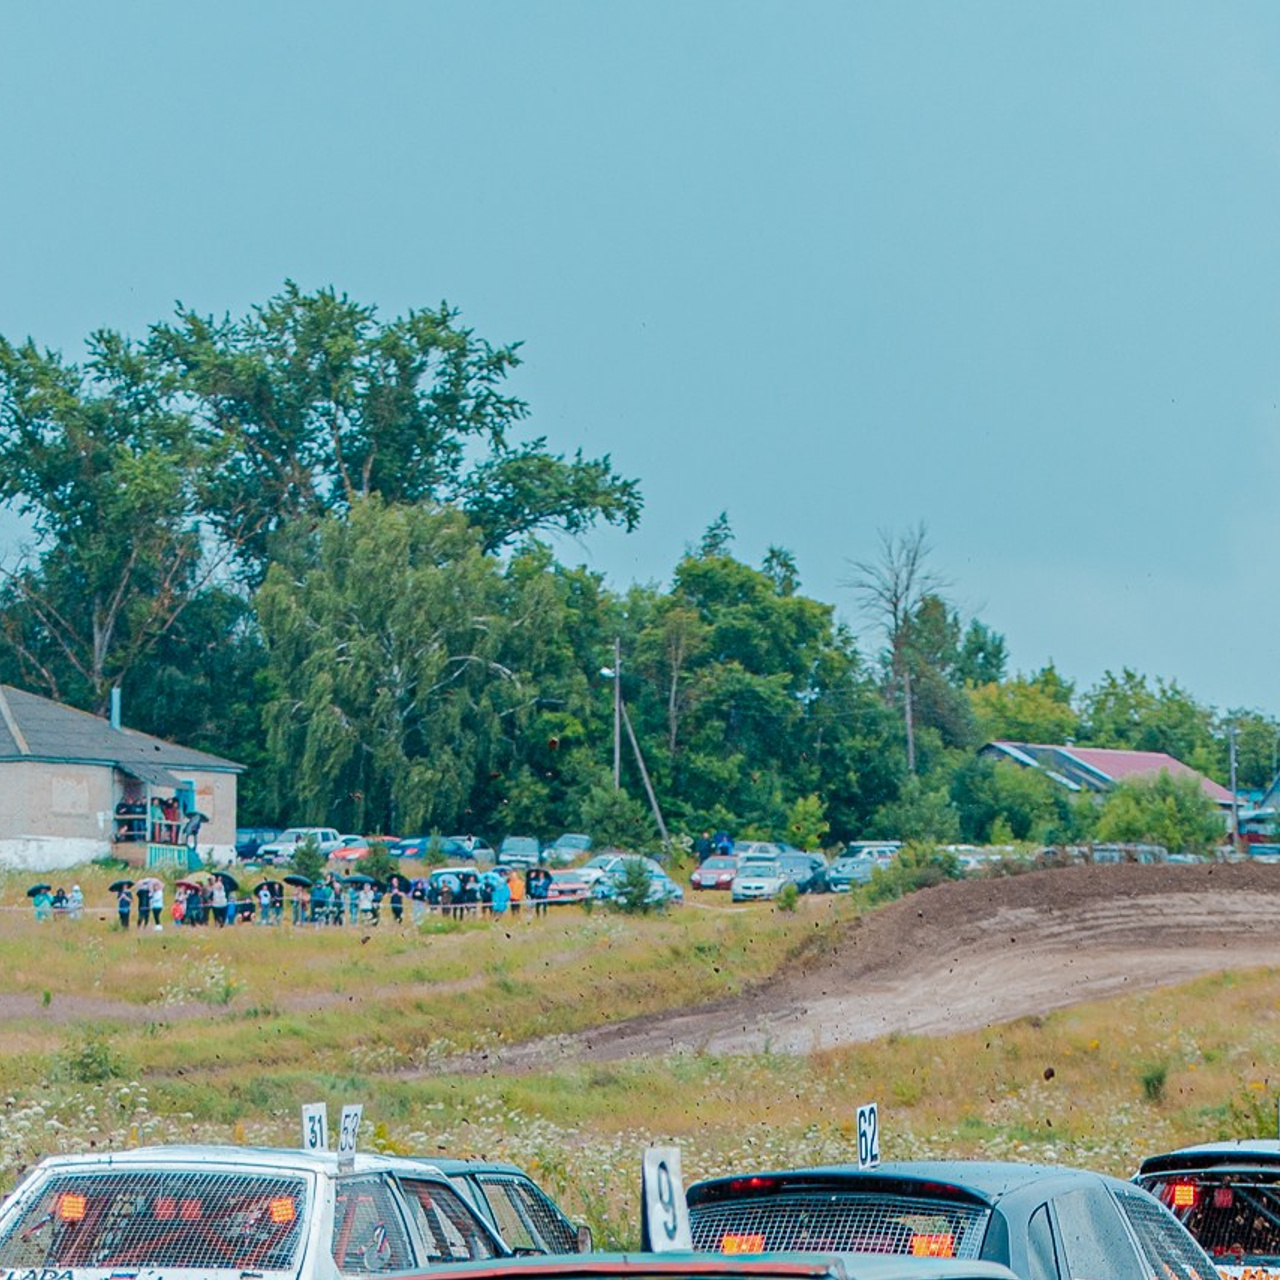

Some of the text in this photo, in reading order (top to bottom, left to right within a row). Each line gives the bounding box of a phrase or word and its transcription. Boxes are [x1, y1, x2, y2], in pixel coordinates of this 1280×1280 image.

[307, 1114, 324, 1149] 31
[340, 1112, 360, 1152] 53
[858, 1107, 879, 1167] 62
[657, 1160, 677, 1241] 9
